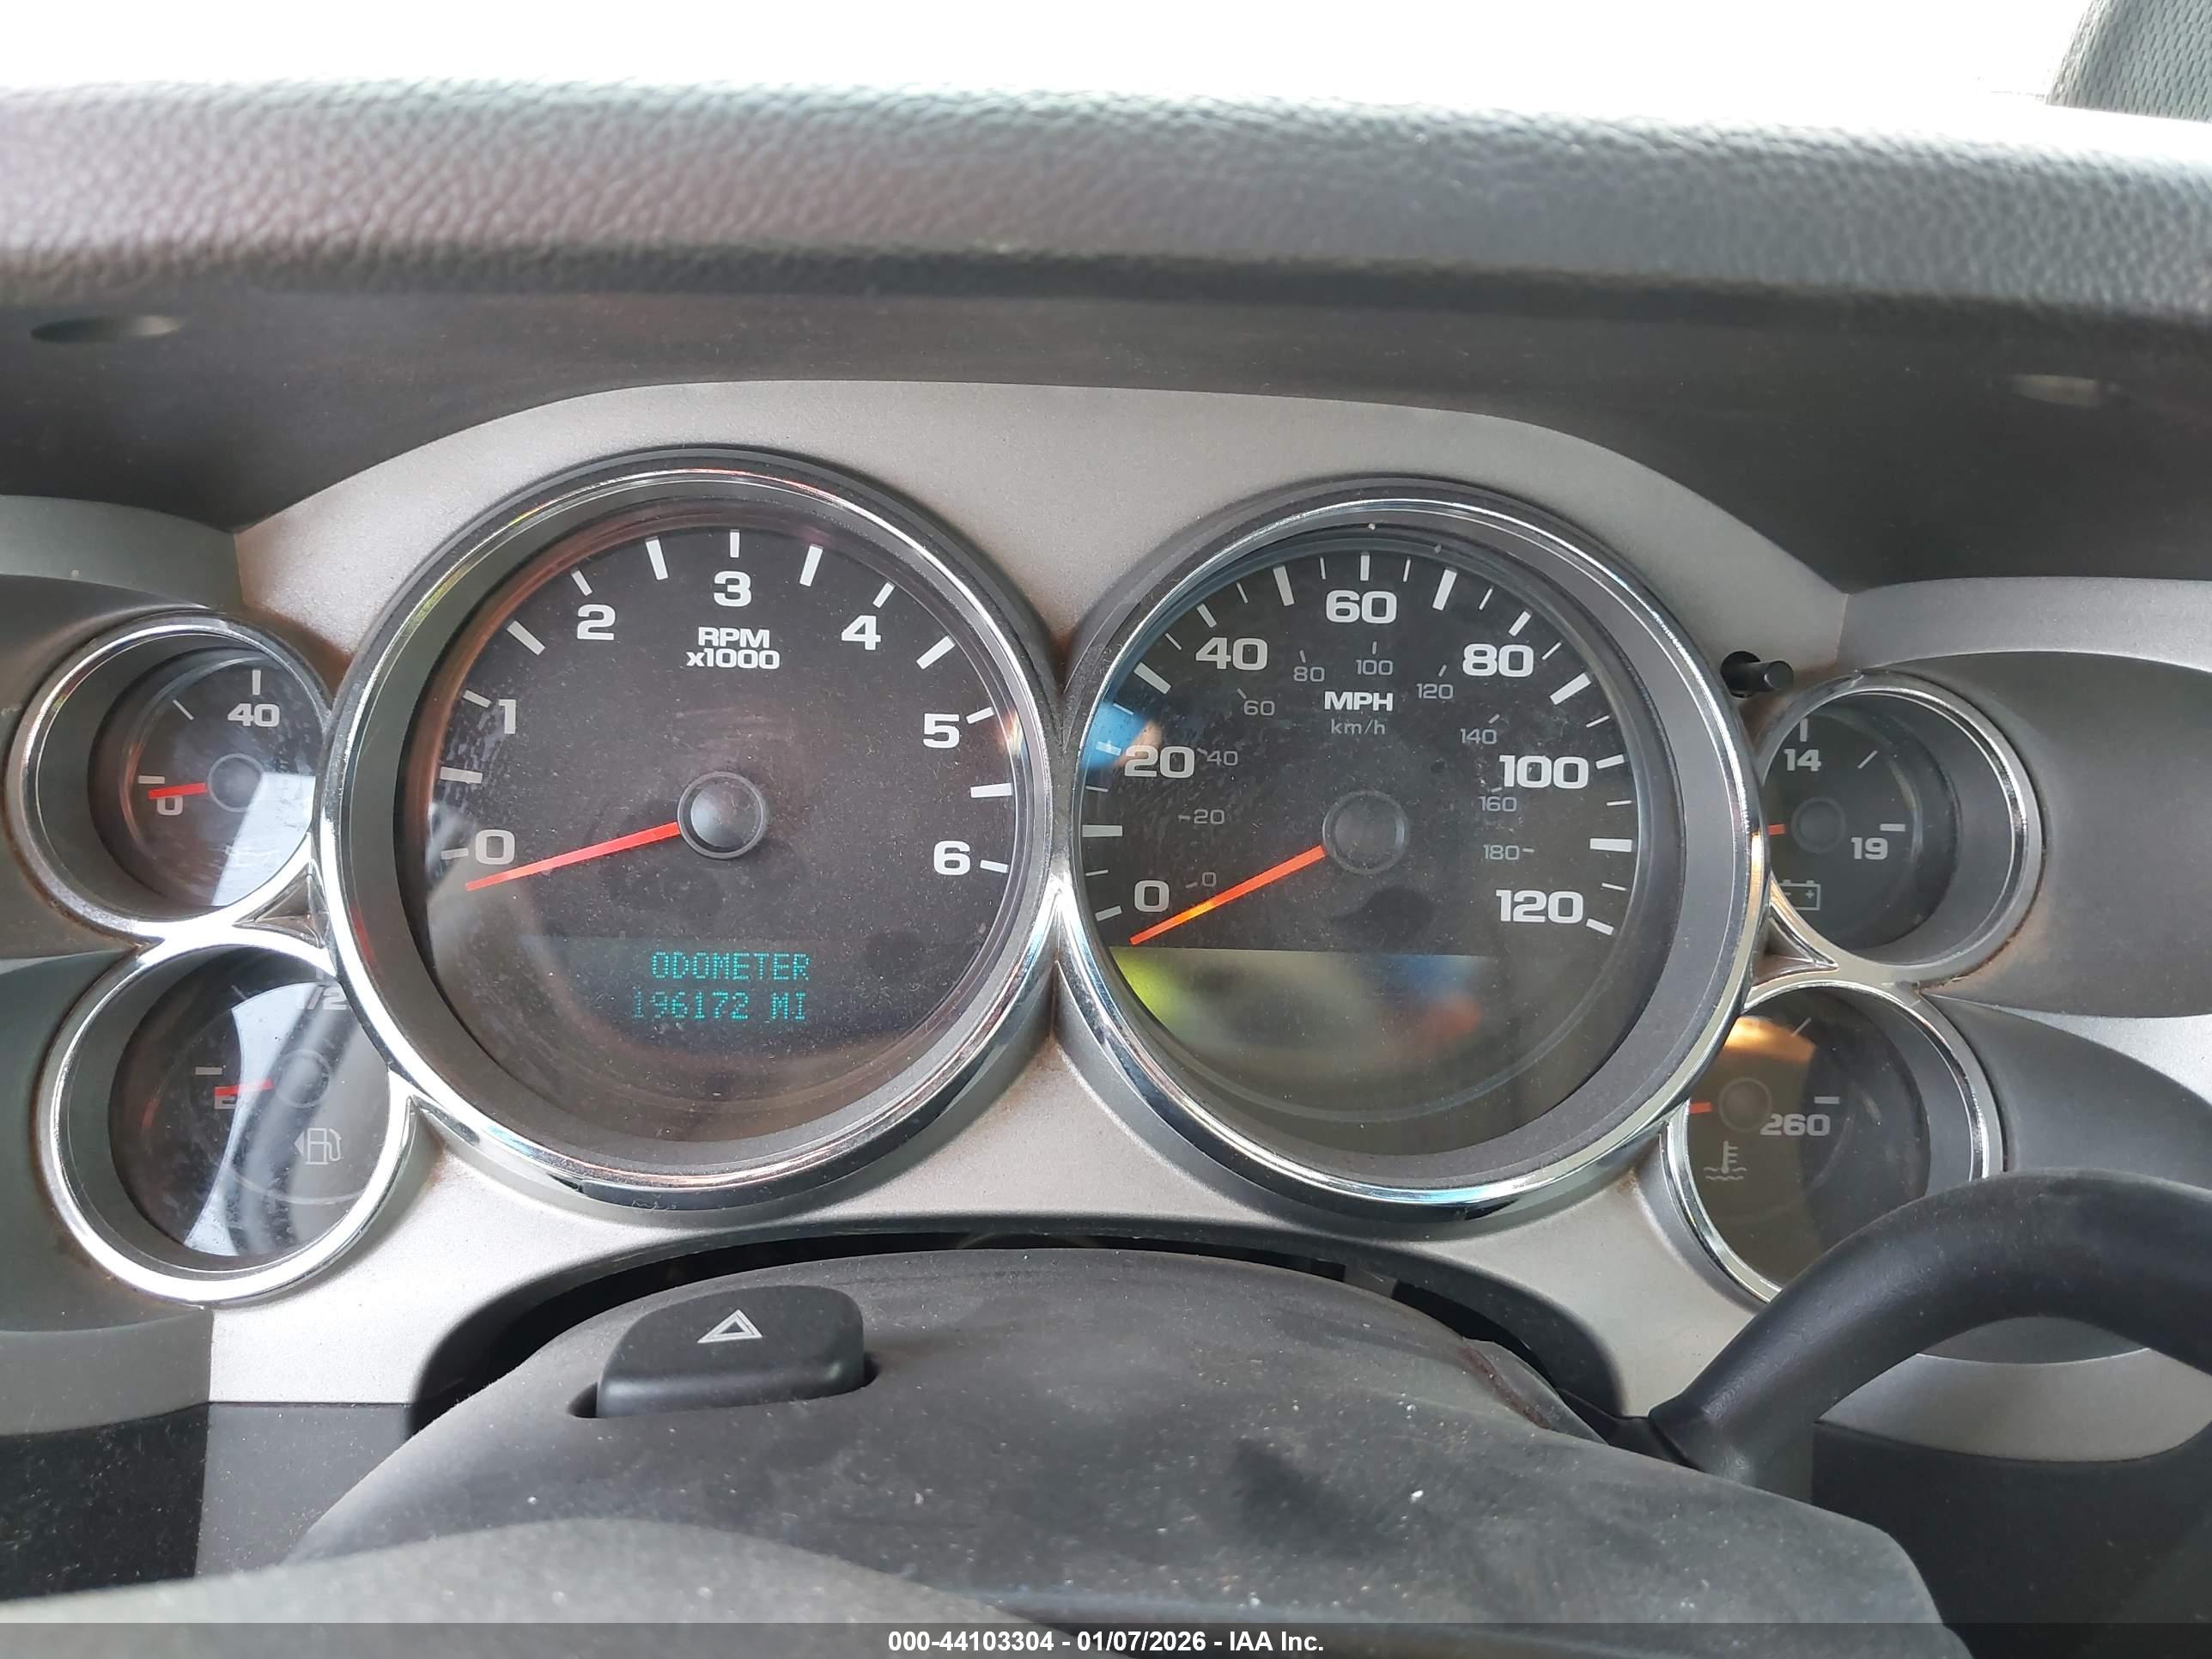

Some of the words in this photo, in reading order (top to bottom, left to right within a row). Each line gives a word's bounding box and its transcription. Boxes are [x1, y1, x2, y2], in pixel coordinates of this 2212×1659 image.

[714, 570, 752, 607] 3
[1326, 590, 1397, 624] 60
[576, 604, 616, 641] 2
[841, 615, 882, 651] 4
[698, 626, 770, 649] RPM
[686, 647, 781, 670] x1000
[1195, 637, 1268, 671] 40
[1462, 643, 1534, 678] 80
[1293, 665, 1325, 683] 80
[1355, 659, 1394, 676] 100
[1324, 690, 1394, 712] MPH
[1416, 683, 1454, 700] 120
[227, 702, 280, 727] 40
[497, 697, 517, 736] 1
[1243, 700, 1275, 716] 60
[922, 713, 960, 749] 5
[1331, 718, 1386, 735] km/h
[1460, 727, 1498, 744] 140
[1124, 745, 1196, 780] 20
[1206, 750, 1239, 767] 40
[1784, 748, 1822, 772] 14
[1498, 755, 1589, 789] 100
[1479, 795, 1518, 812] 160
[1194, 809, 1226, 826] 20
[474, 828, 517, 866] 0
[933, 840, 971, 876] 6
[1483, 844, 1520, 861] 180
[1850, 836, 1888, 860] 19
[1201, 872, 1218, 888] 0
[1133, 879, 1170, 913] 0
[1495, 889, 1583, 924] 120
[651, 951, 810, 981] ODOMETER
[634, 991, 749, 1020] 196172
[772, 993, 806, 1020] MI
[1759, 1113, 1831, 1136] 260
